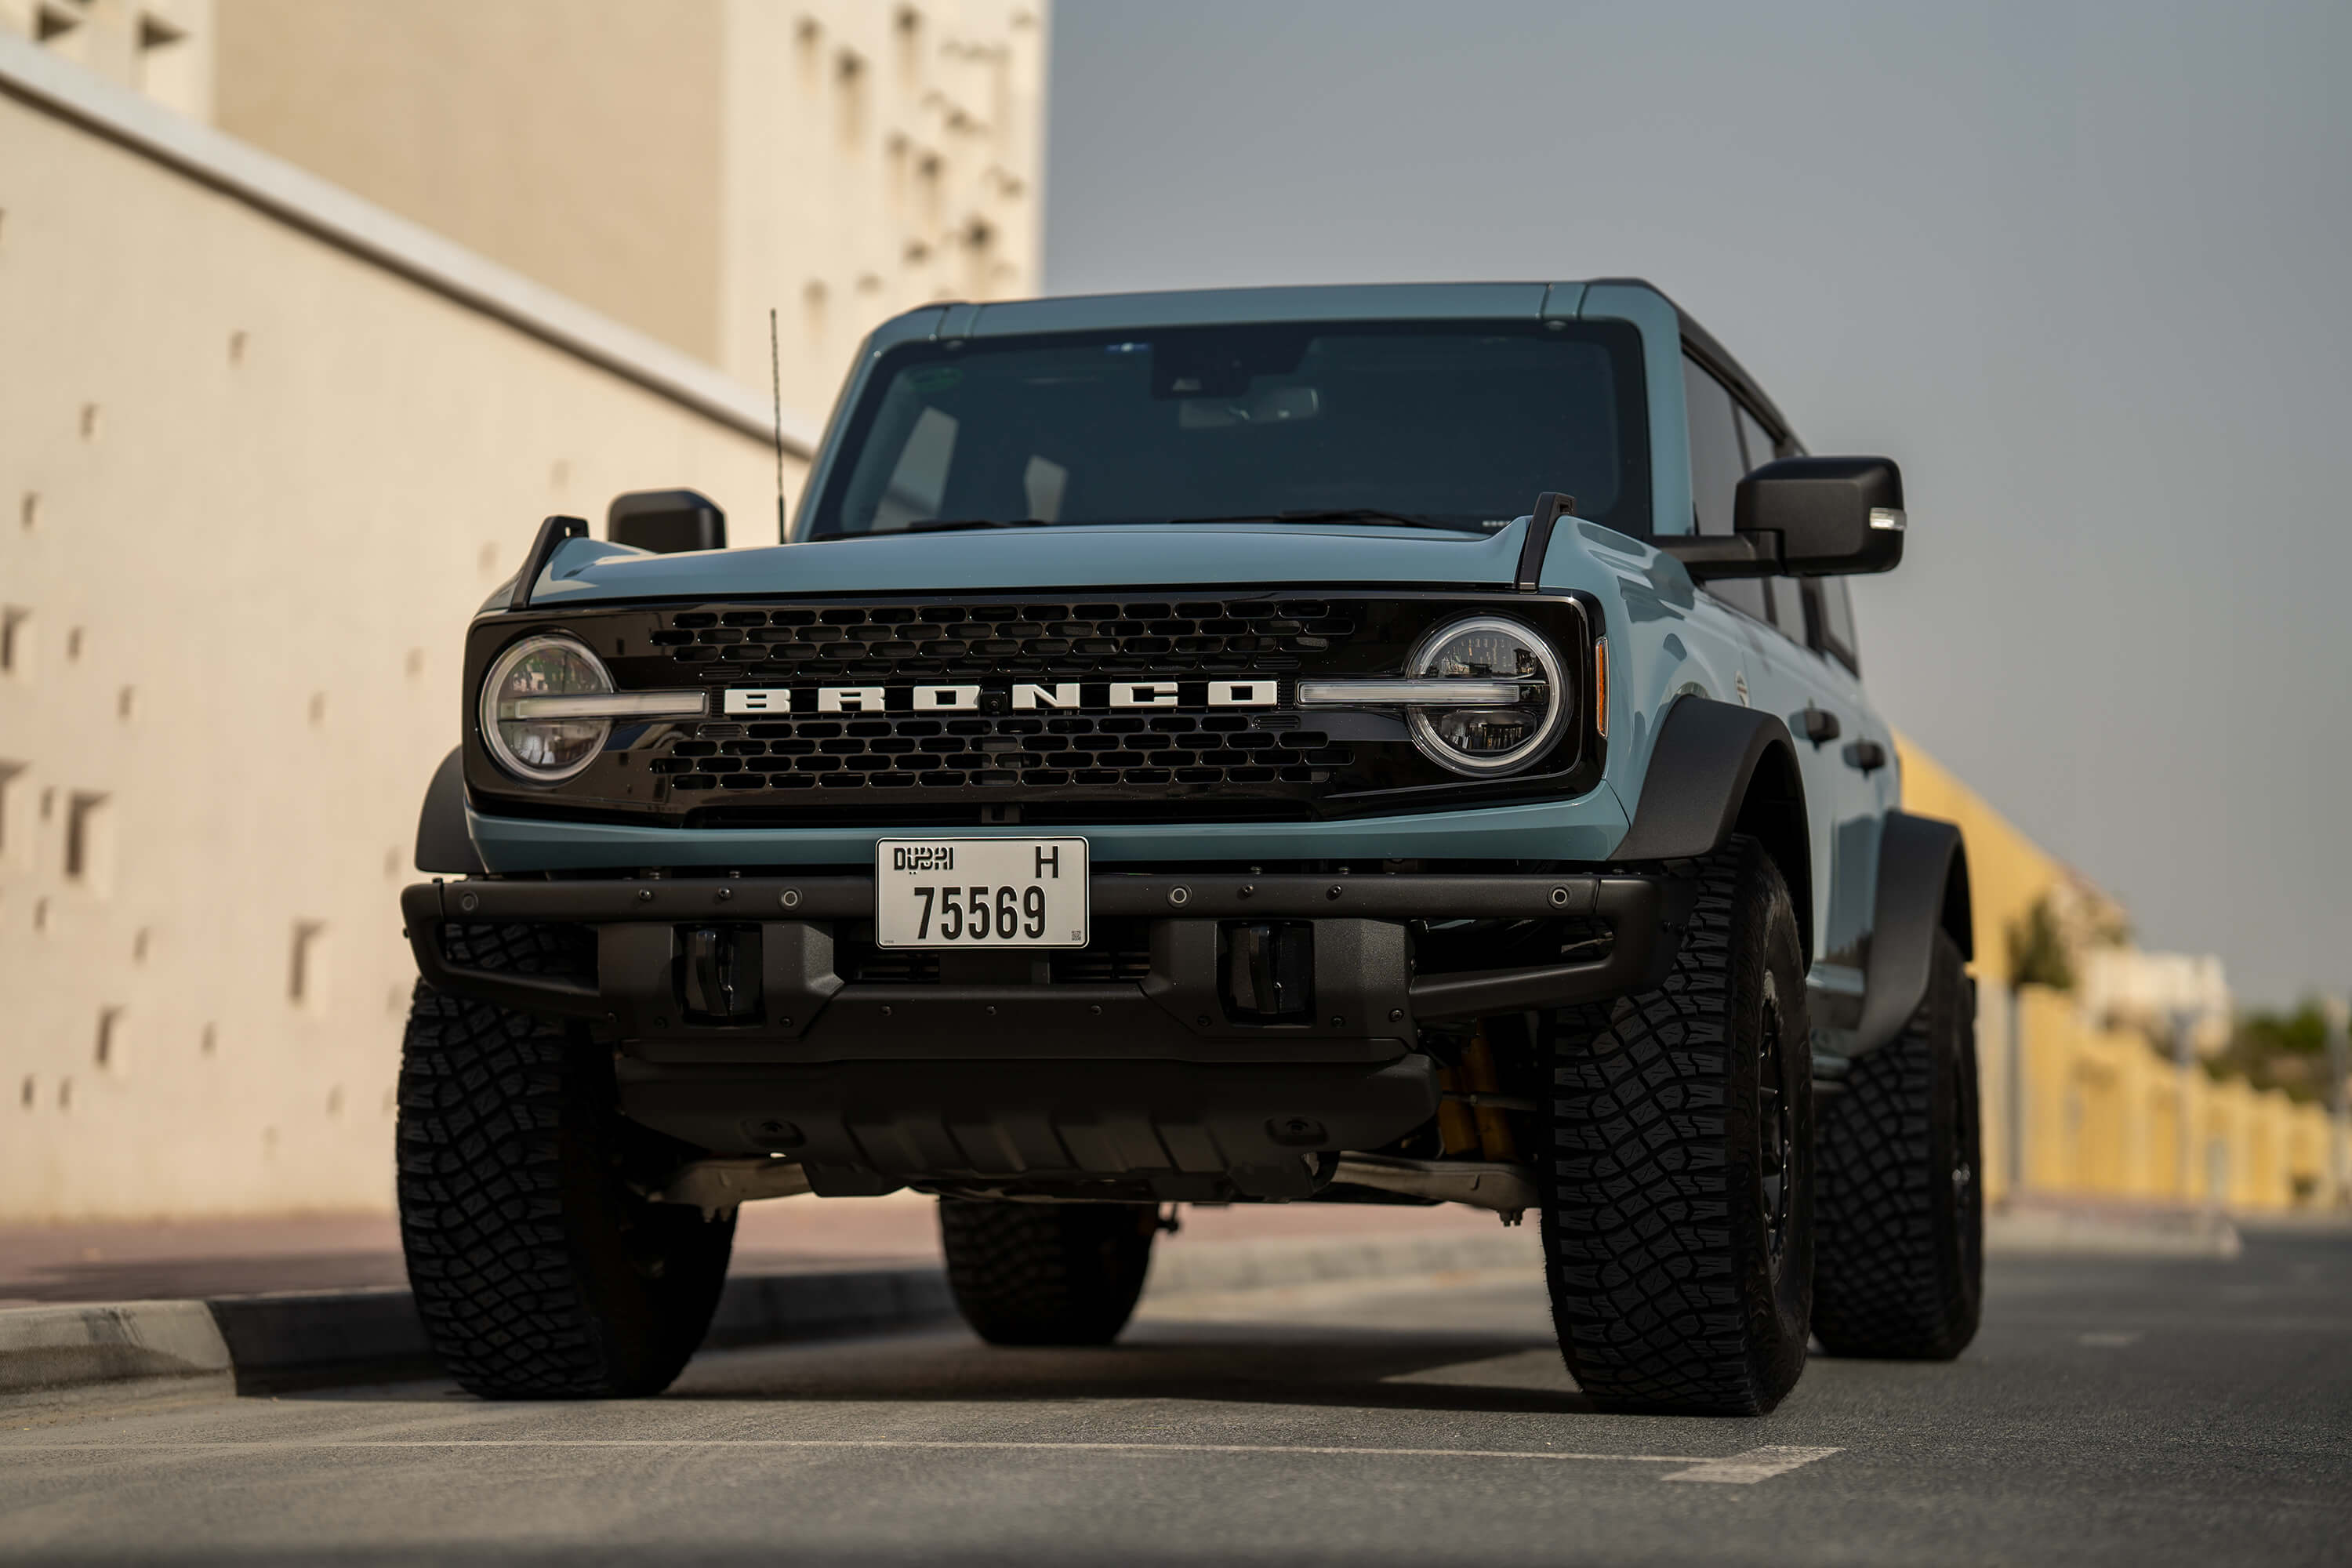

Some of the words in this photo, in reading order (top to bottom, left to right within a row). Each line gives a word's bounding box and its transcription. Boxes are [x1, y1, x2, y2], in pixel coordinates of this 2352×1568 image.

[724, 681, 1278, 715] BRONCO
[1035, 845, 1059, 879] H
[913, 885, 1046, 940] 75569
